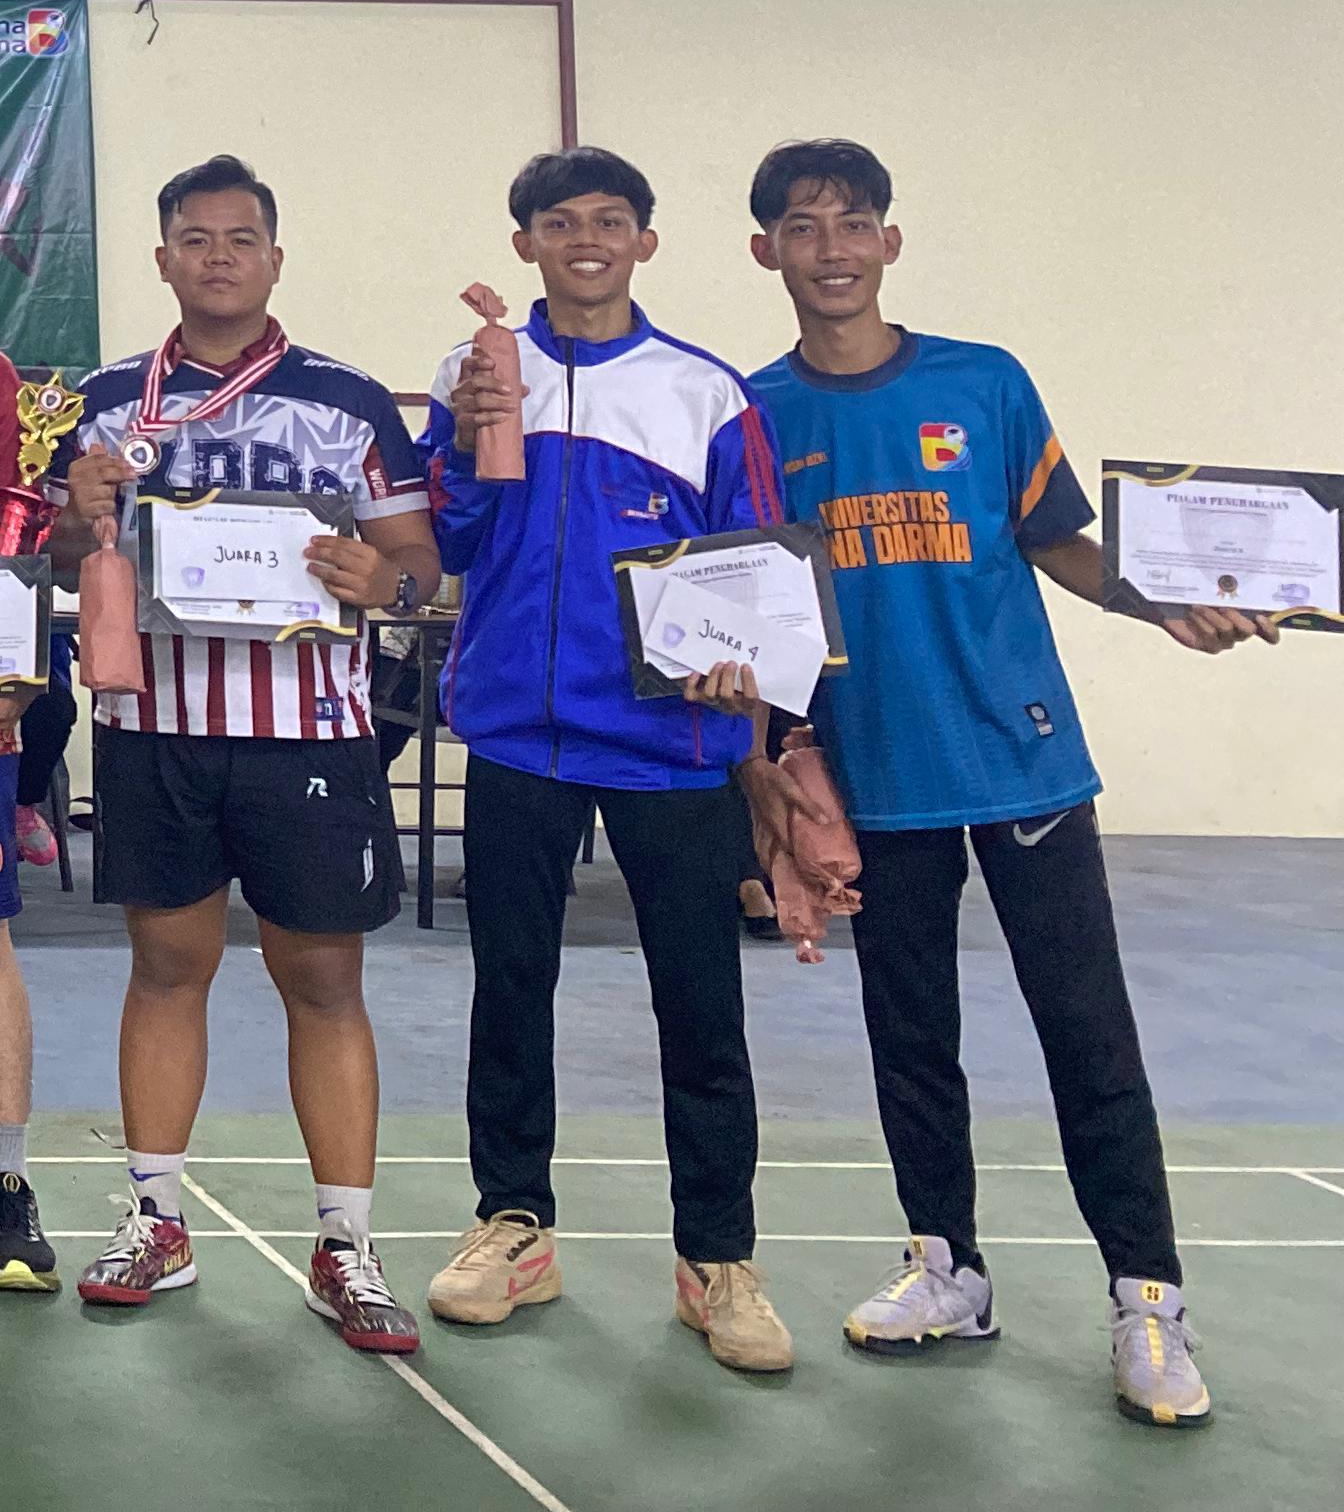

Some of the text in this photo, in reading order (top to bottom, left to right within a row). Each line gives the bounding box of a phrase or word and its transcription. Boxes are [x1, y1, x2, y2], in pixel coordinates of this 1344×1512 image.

[872, 523, 973, 565] DARMA
[213, 545, 280, 568] JUARA 3
[747, 645, 760, 662] 4
